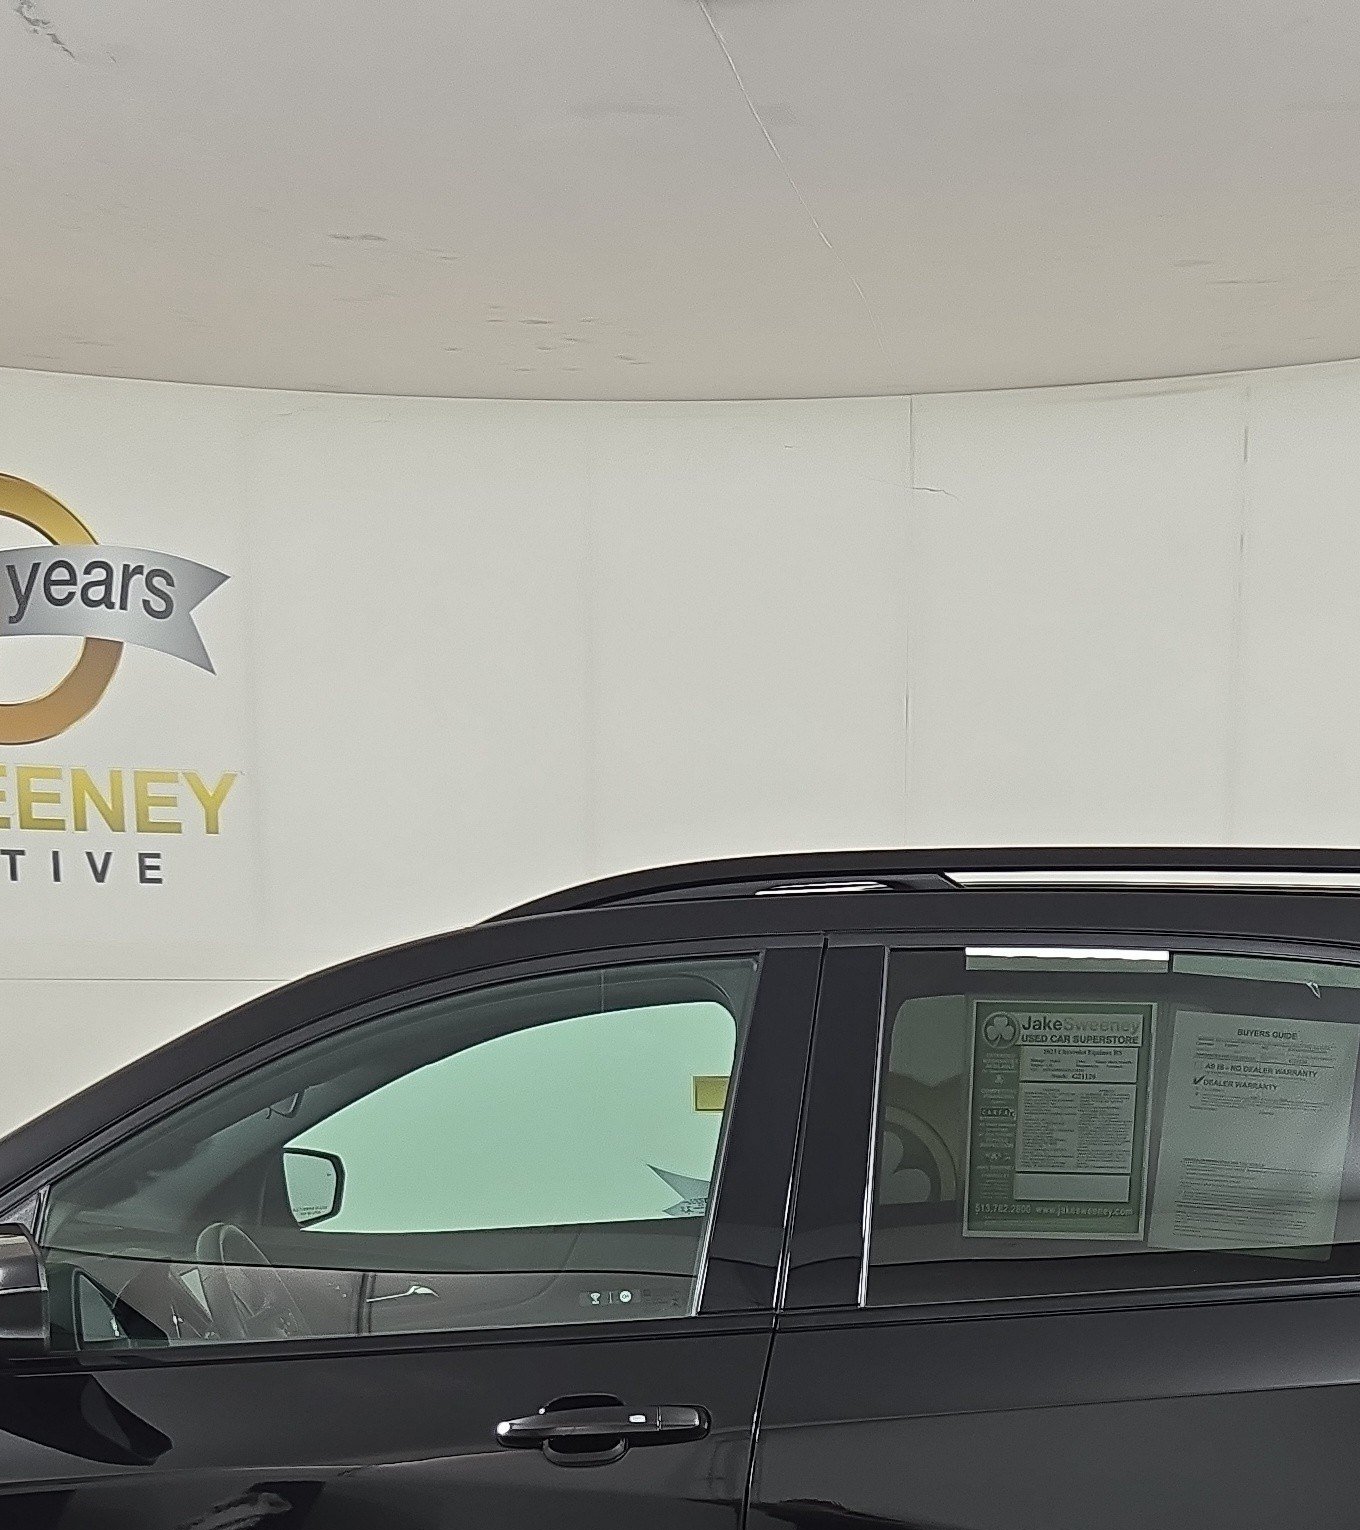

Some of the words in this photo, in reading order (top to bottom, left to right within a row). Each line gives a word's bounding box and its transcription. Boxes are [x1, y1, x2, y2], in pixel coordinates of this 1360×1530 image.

[5, 558, 177, 625] years
[1021, 1034, 1048, 1043] USED
[1050, 1034, 1070, 1044] CAR
[1072, 1035, 1139, 1045] SUPERSTORE
[1237, 1028, 1271, 1038] BUYERS
[1272, 1031, 1298, 1040] GUIDE
[1243, 1065, 1273, 1074] DEALER
[1274, 1068, 1318, 1077] WARRANTY
[1203, 1079, 1234, 1088] DEALER
[1235, 1081, 1278, 1091] WARRANTY
